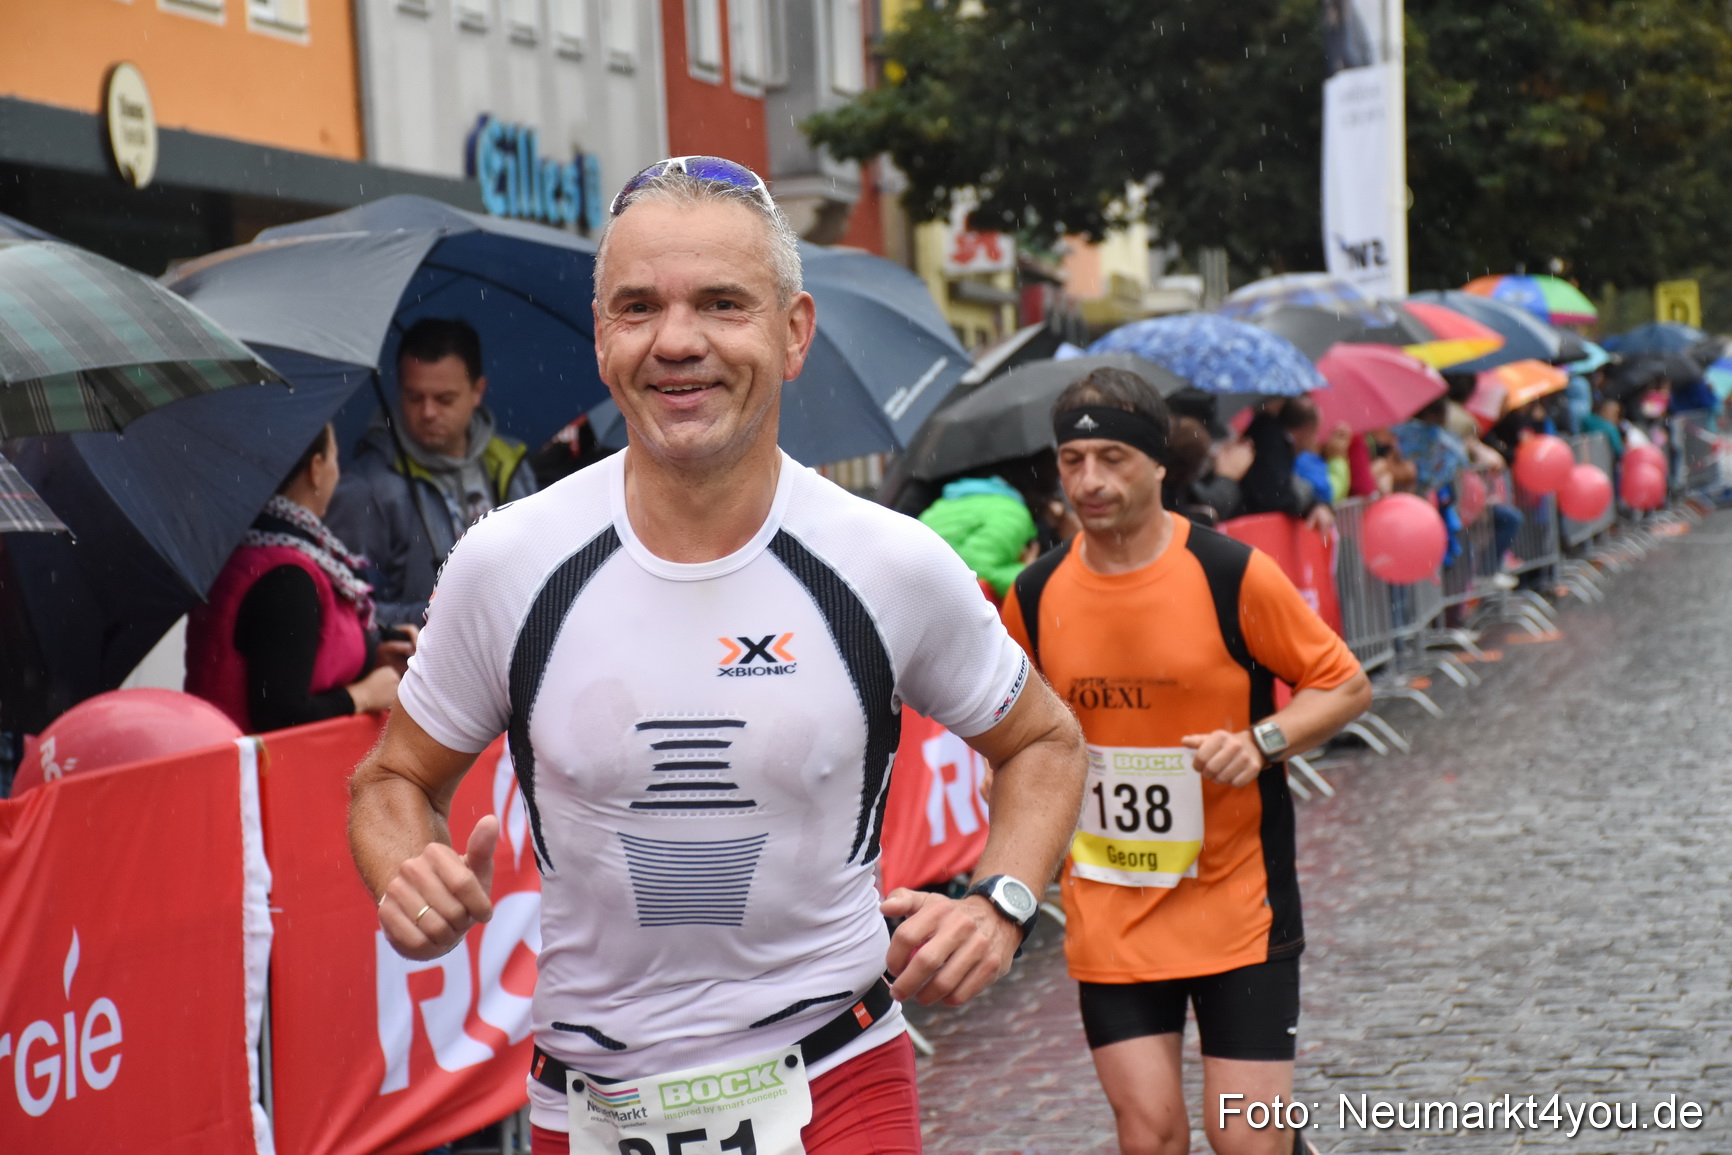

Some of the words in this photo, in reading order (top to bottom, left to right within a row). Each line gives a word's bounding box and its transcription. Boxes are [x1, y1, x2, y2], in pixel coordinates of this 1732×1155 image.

[716, 663, 797, 677] X-BIONIC
[1113, 753, 1185, 770] BOCK
[1092, 782, 1173, 834] 138
[1106, 844, 1158, 872] Georg
[658, 1060, 784, 1110] BOCK
[663, 1106, 701, 1121] inspired
[703, 1105, 715, 1114] by
[717, 1099, 745, 1111] smart
[747, 1087, 788, 1105] concepts
